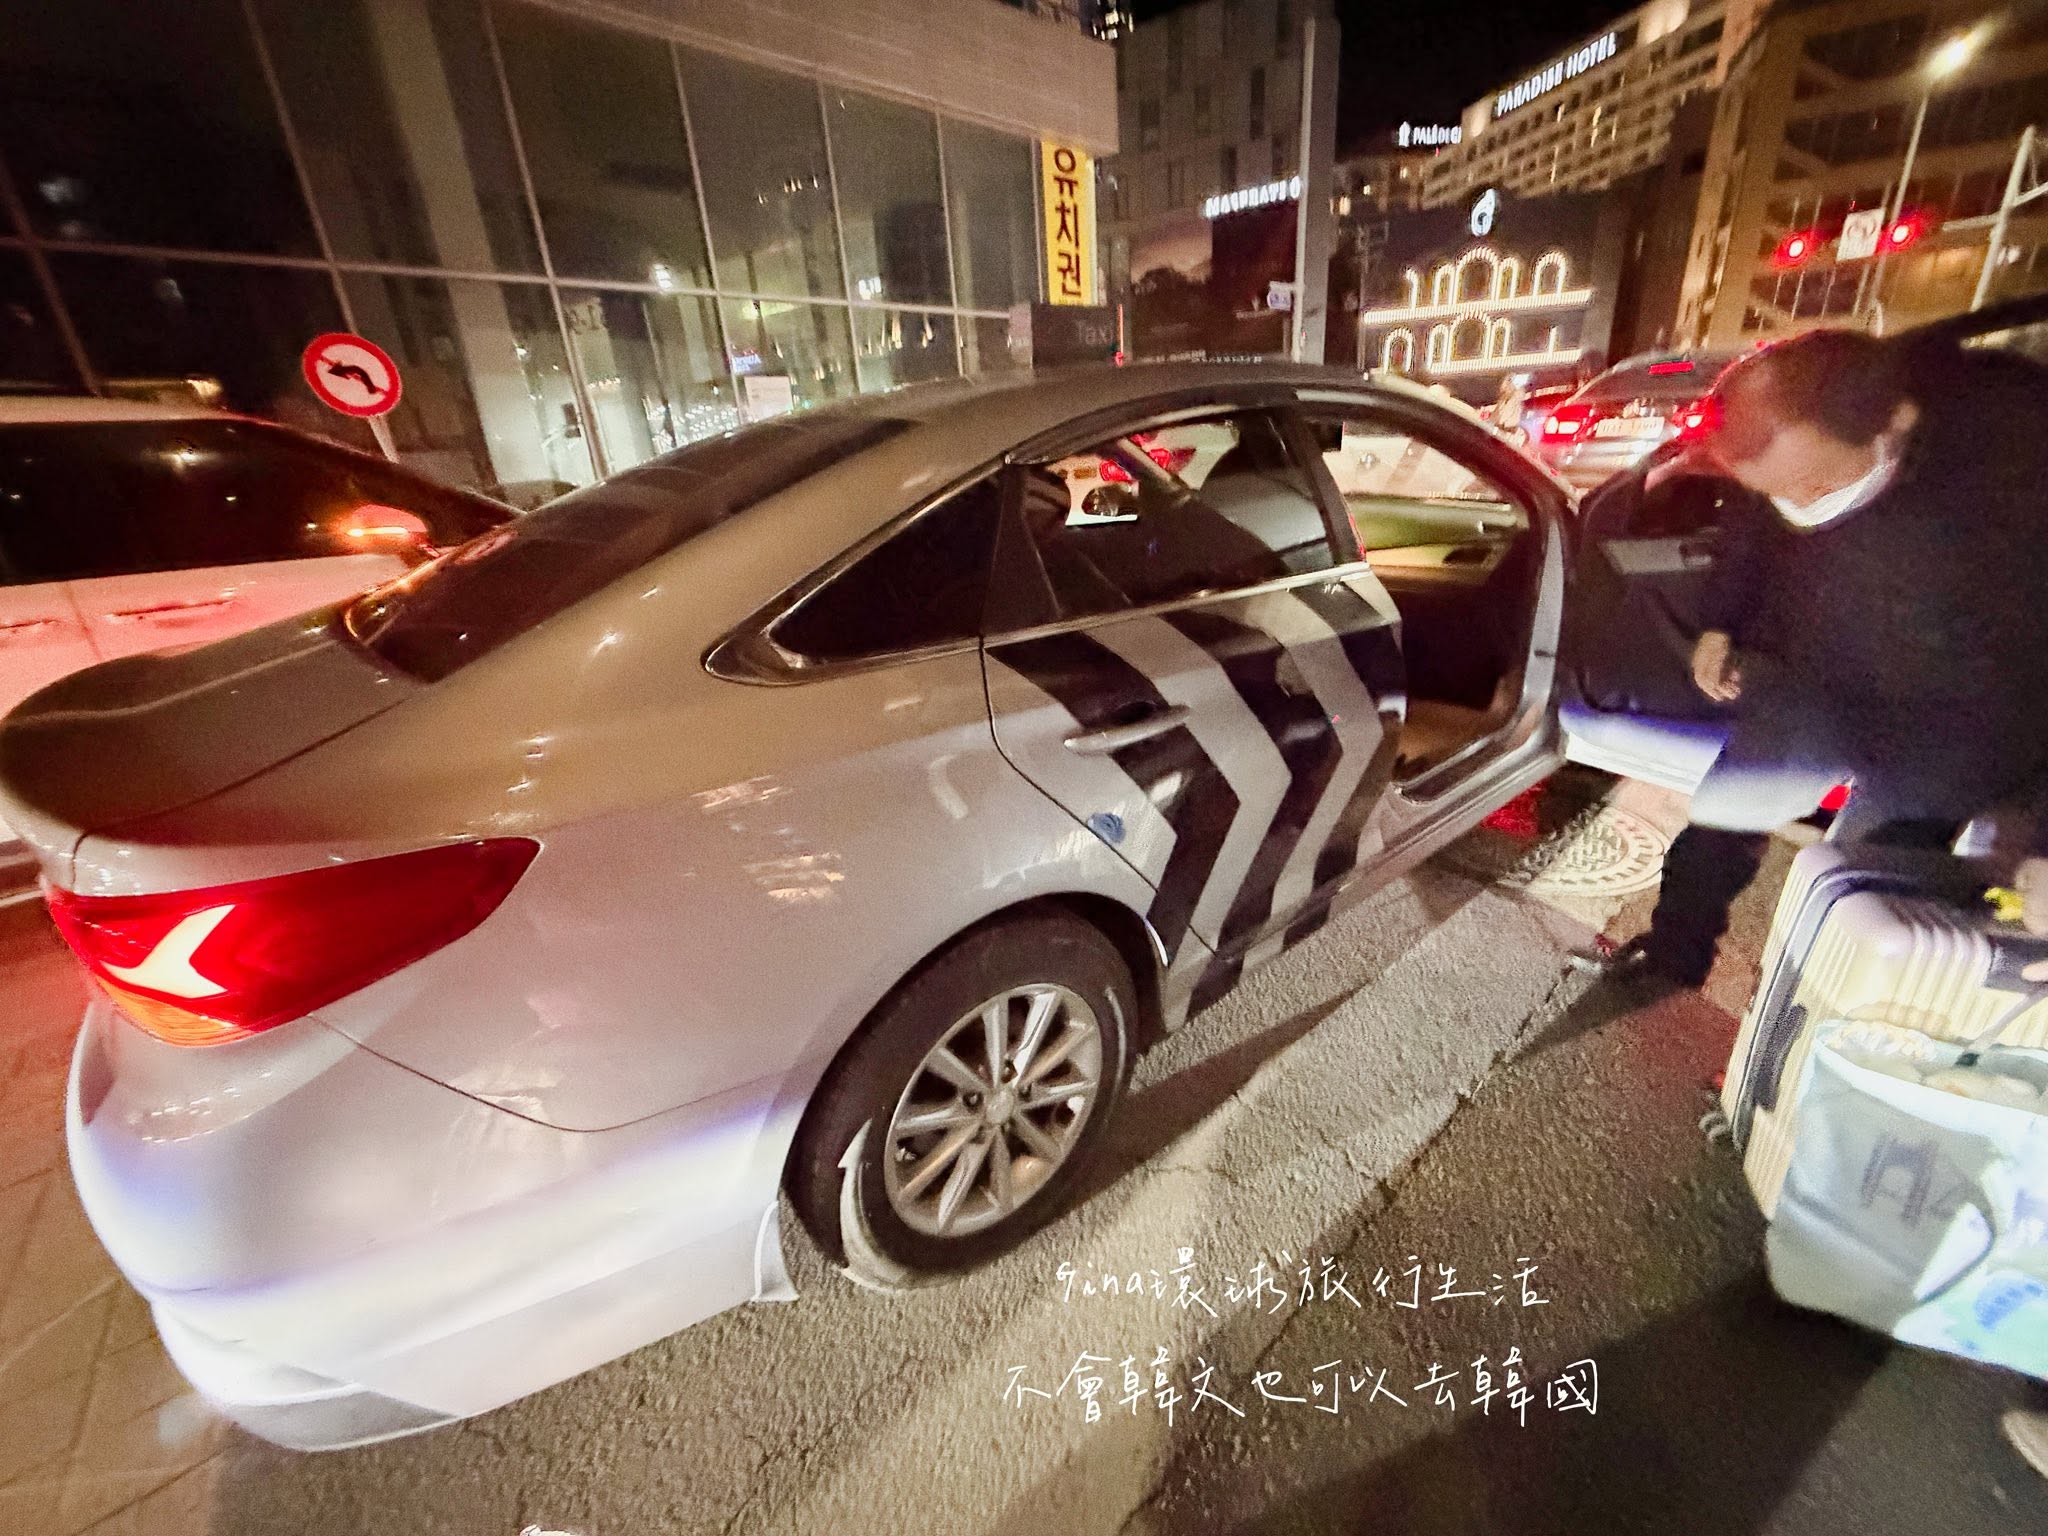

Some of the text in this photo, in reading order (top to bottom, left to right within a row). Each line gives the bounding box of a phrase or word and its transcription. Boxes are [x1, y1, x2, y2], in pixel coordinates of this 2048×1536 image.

[1497, 31, 1617, 117] PARADISE HOTEL
[1054, 148, 1081, 297] 유치권
